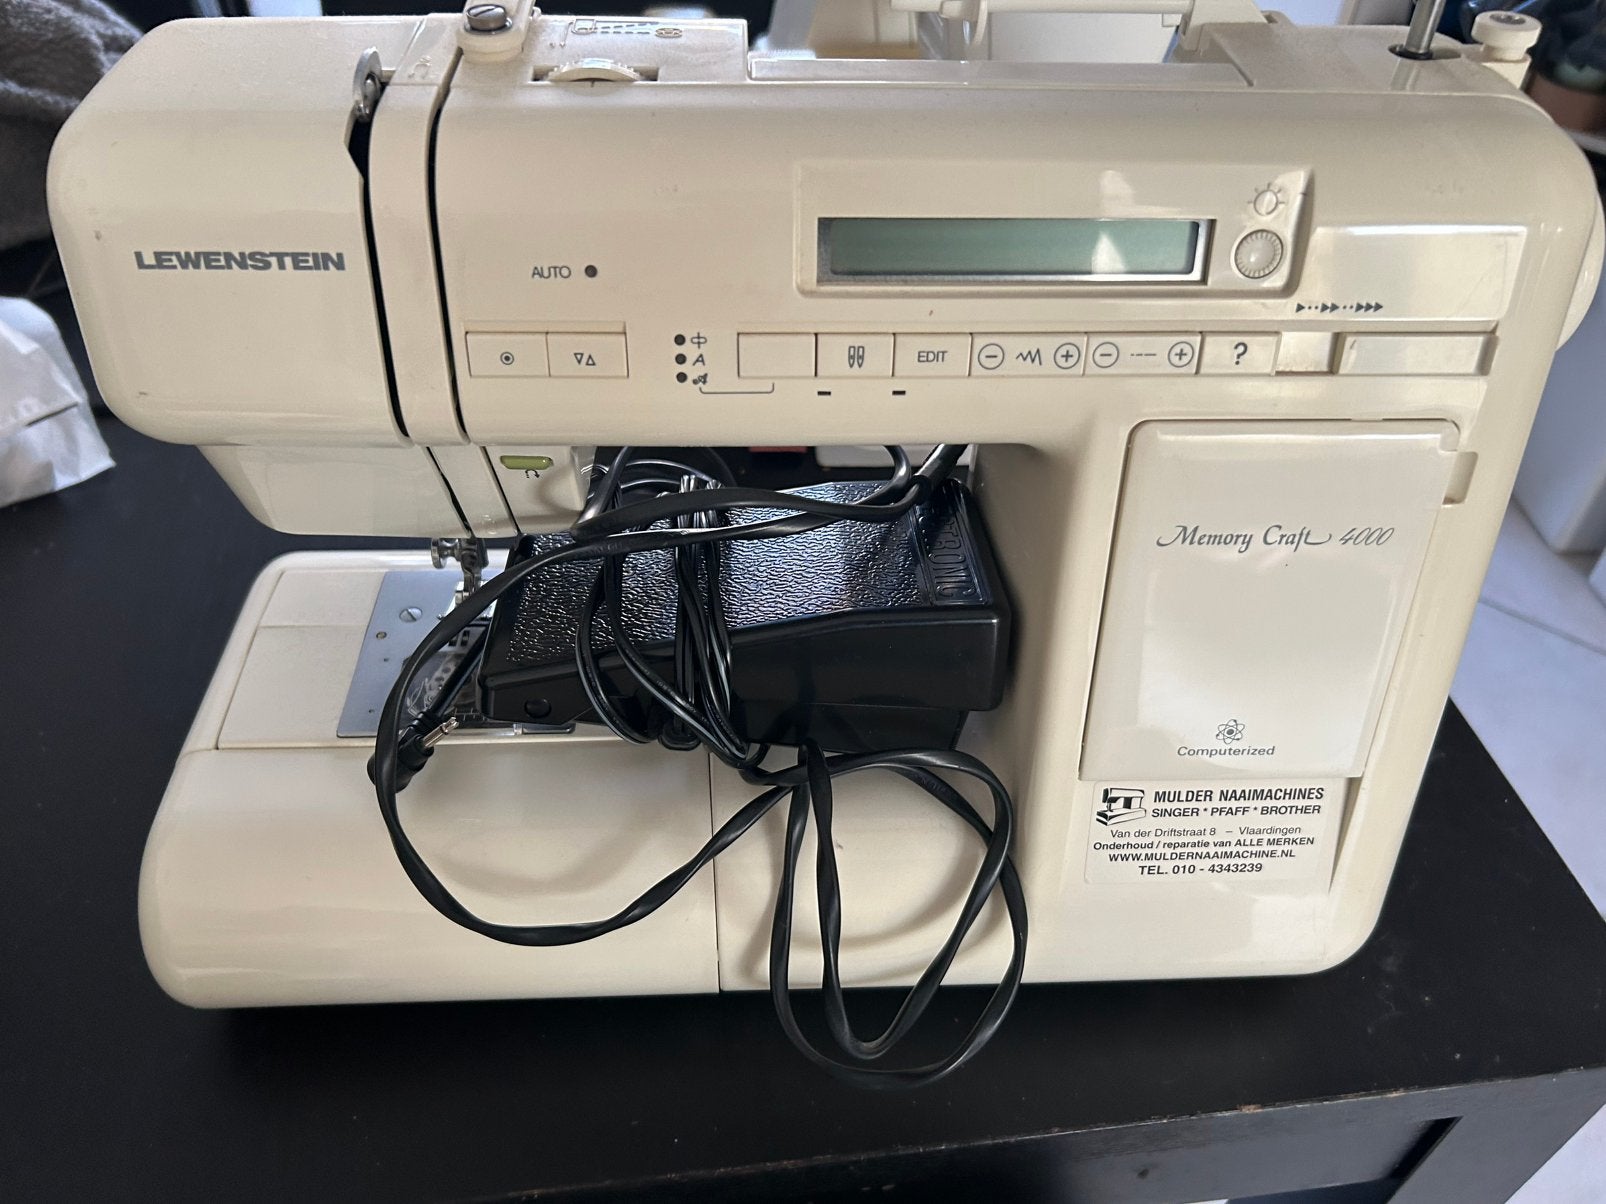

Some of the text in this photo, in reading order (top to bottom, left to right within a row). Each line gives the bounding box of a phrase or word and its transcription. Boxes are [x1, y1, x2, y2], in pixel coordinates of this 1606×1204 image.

[134, 251, 345, 271] LEWENSTEIN
[531, 265, 572, 279] AUTO
[917, 350, 948, 363] EDIT
[1156, 524, 1395, 553] Memory Craft 4000
[1177, 745, 1276, 758] Computerized
[1153, 787, 1325, 803] MULDER NAAIMACHINES
[1151, 804, 1322, 818] SINGER PFAFF BROTHER
[1110, 829, 1131, 839] Van
[1133, 828, 1151, 838] der
[1154, 827, 1207, 838] Driftstraat
[1209, 827, 1217, 836] 8
[1238, 826, 1302, 837] Vlaardingen
[1093, 840, 1154, 851] Onderhoud
[1162, 839, 1210, 852] reparatie
[1213, 839, 1232, 848] van
[1234, 838, 1263, 847] ALLE
[1266, 837, 1315, 846] MERKEN
[1108, 849, 1296, 862] WWW.MULDERNAAIMACHINE.NL
[1138, 864, 1168, 875] TEL.
[1172, 864, 1196, 875] 010
[1207, 862, 1263, 874] 4343239
